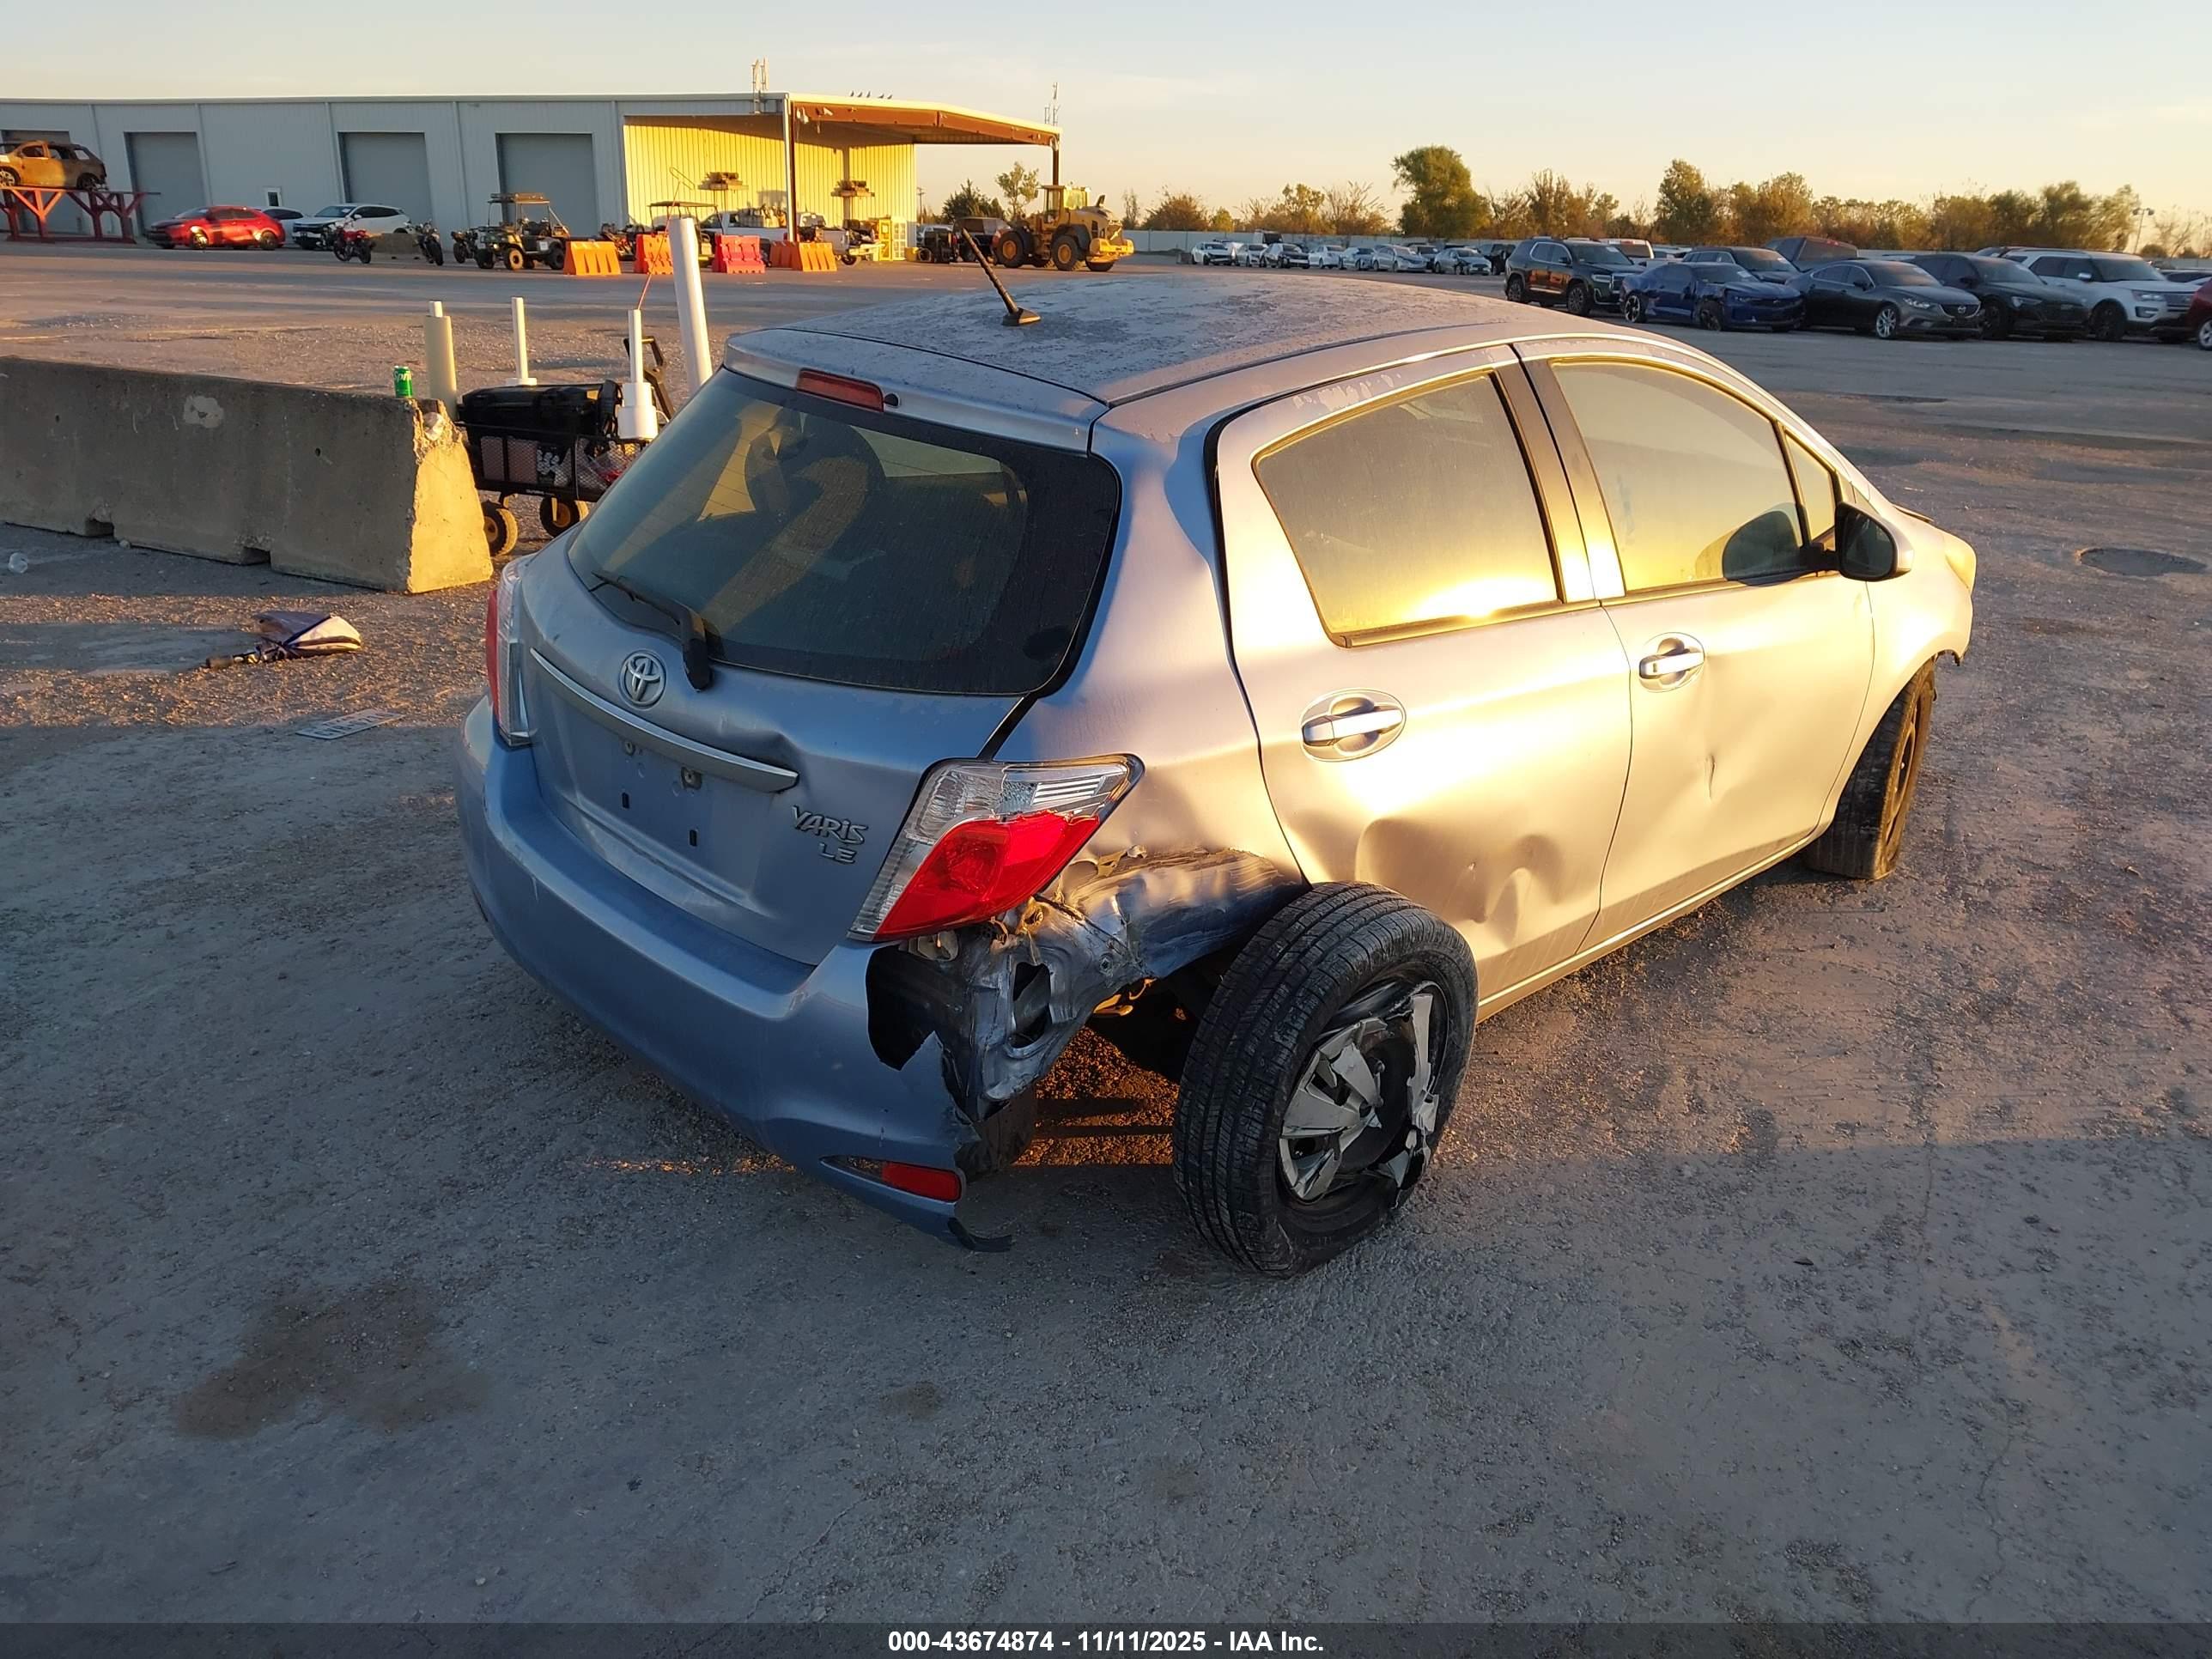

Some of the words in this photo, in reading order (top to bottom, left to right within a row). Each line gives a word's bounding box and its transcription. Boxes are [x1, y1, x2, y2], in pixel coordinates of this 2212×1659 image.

[393, 370, 412, 383] Spri
[791, 805, 868, 845] YARIS
[817, 842, 857, 864] LE
